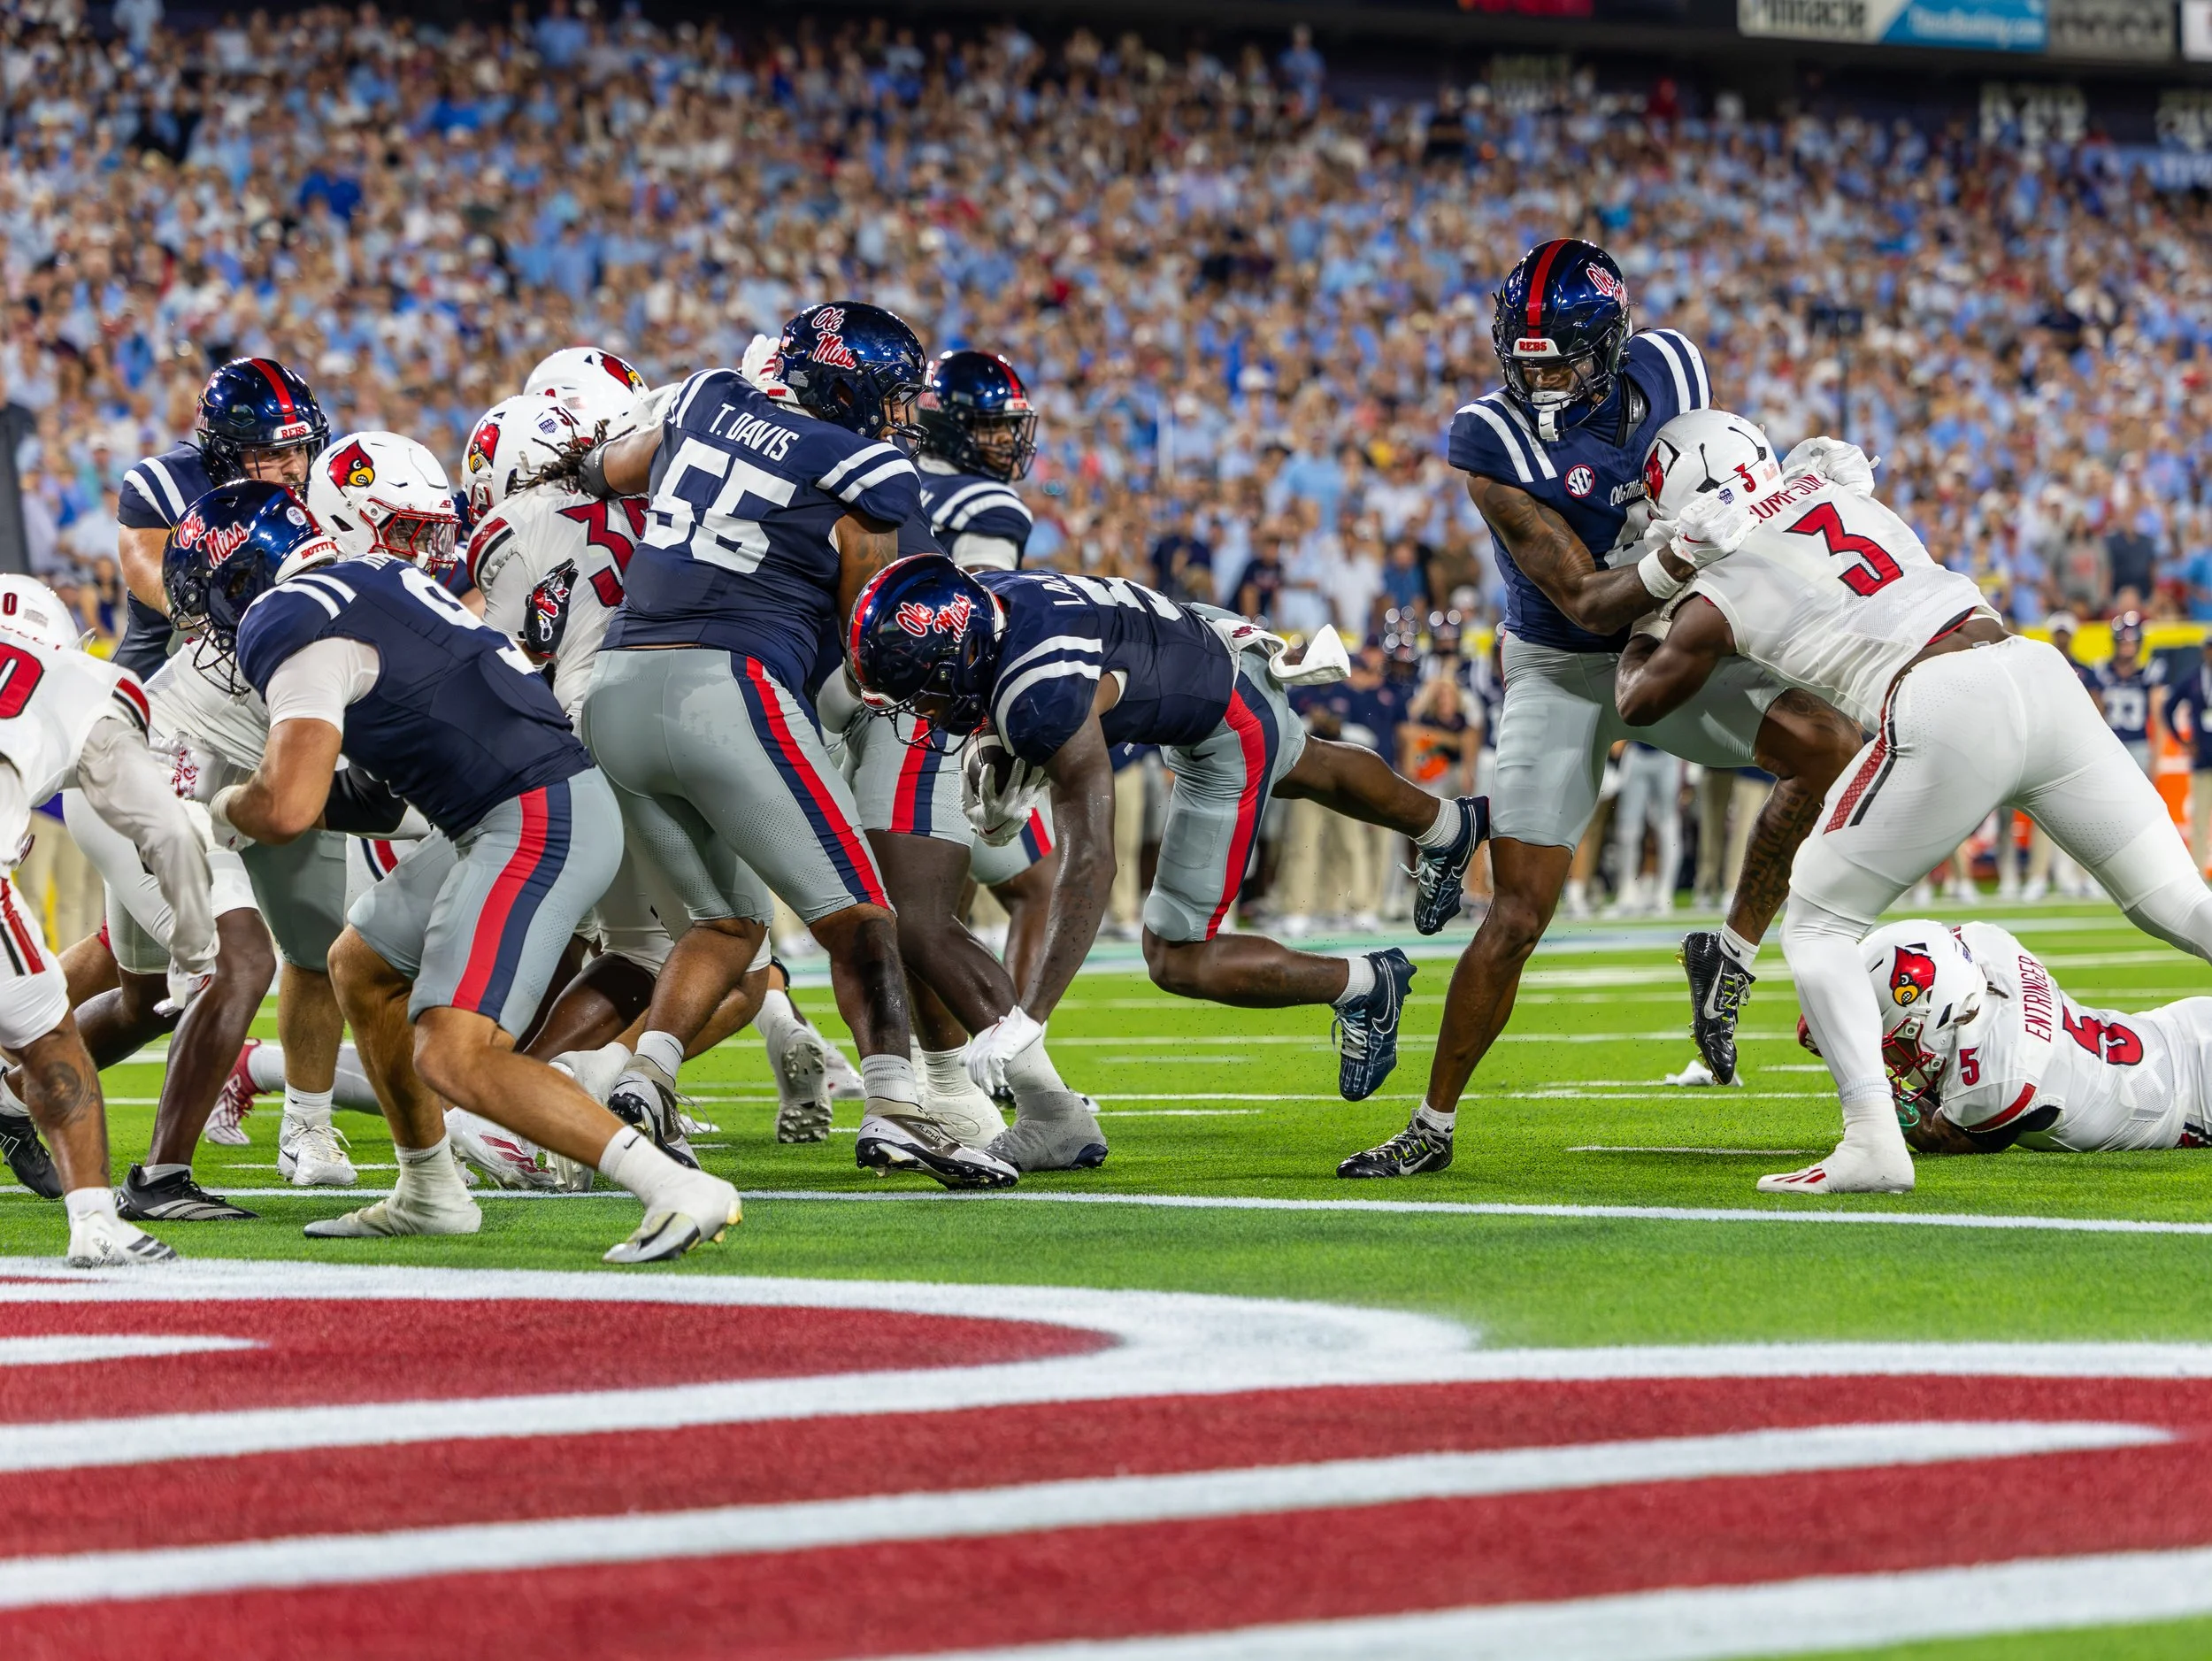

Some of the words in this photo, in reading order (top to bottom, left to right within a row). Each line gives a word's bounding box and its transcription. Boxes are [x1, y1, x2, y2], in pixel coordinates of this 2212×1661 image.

[1586, 262, 1616, 296] Ole
[811, 306, 845, 332] Ole
[812, 331, 857, 370] Miss
[1518, 341, 1548, 352] REBS
[280, 424, 307, 439] REBS
[709, 403, 735, 435] T.
[725, 411, 800, 461] DAVIS
[1567, 466, 1594, 496] SEC
[1624, 479, 1647, 500] Mis
[1733, 463, 1756, 493] 3
[178, 511, 204, 550] Ole
[196, 521, 250, 570] Miss
[1782, 501, 1904, 597] 3
[3, 592, 18, 616] 0
[895, 602, 934, 637] Ole
[933, 592, 972, 643] Miss
[2017, 955, 2053, 1043] ENTRINGER
[1959, 1046, 1980, 1087] 5
